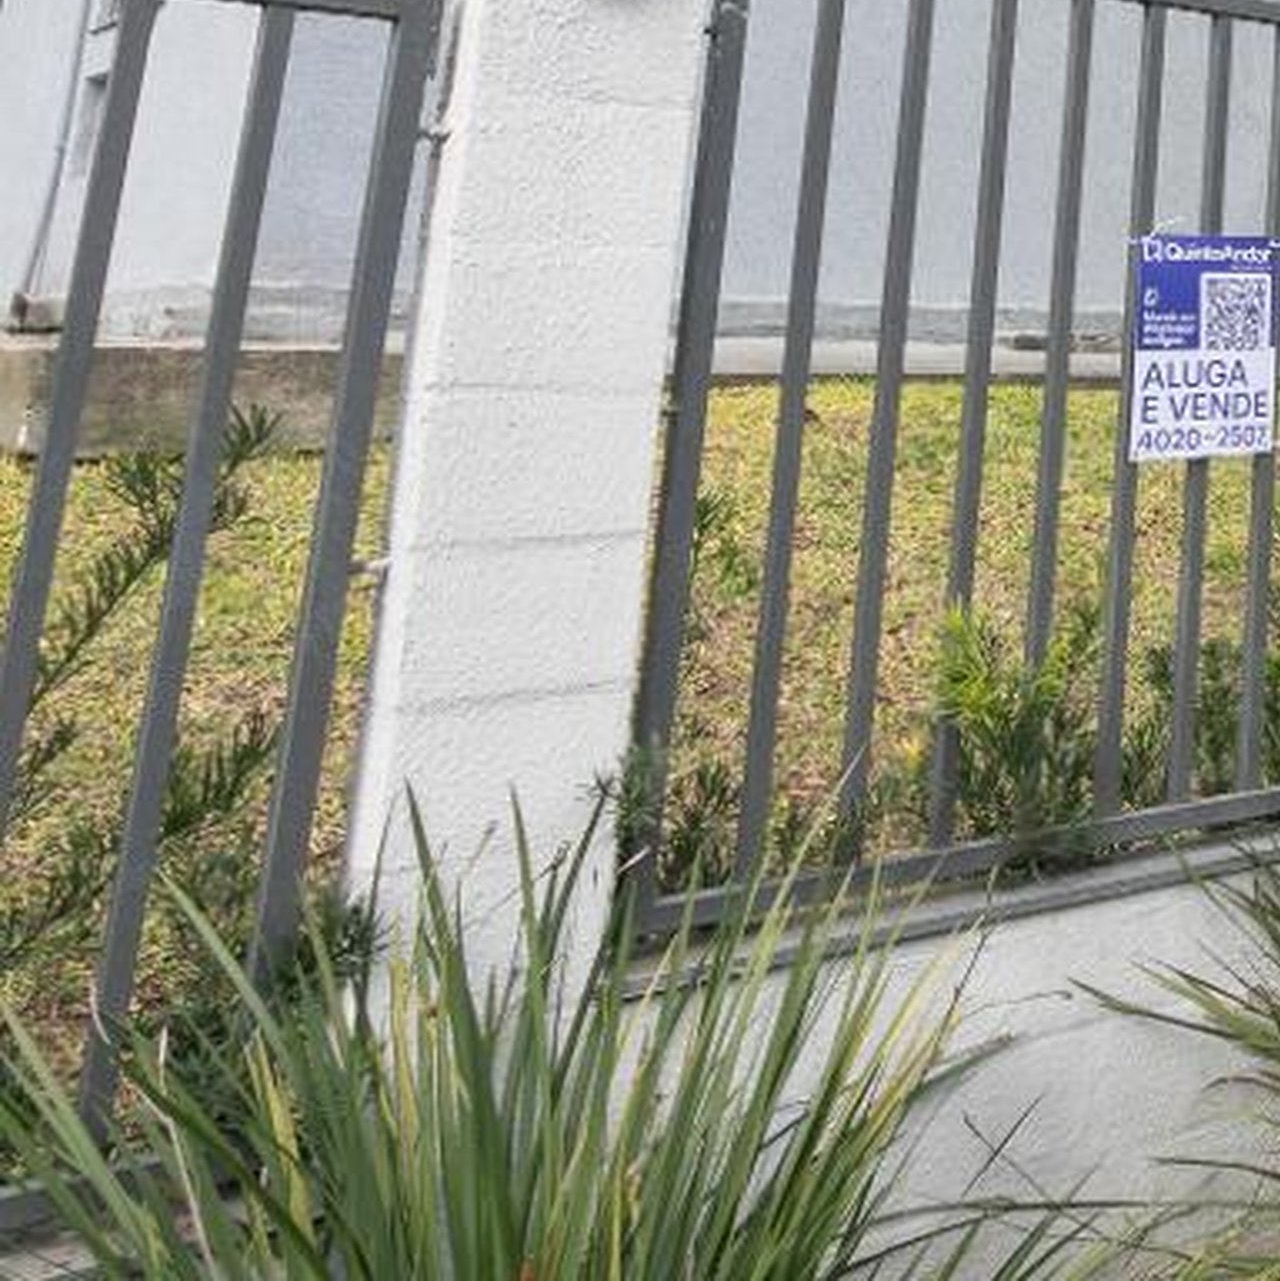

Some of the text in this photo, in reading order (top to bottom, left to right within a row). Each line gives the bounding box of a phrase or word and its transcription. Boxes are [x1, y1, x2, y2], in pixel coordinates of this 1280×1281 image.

[1142, 359, 1249, 390] ALUGA
[1141, 391, 1268, 424] E VENDE
